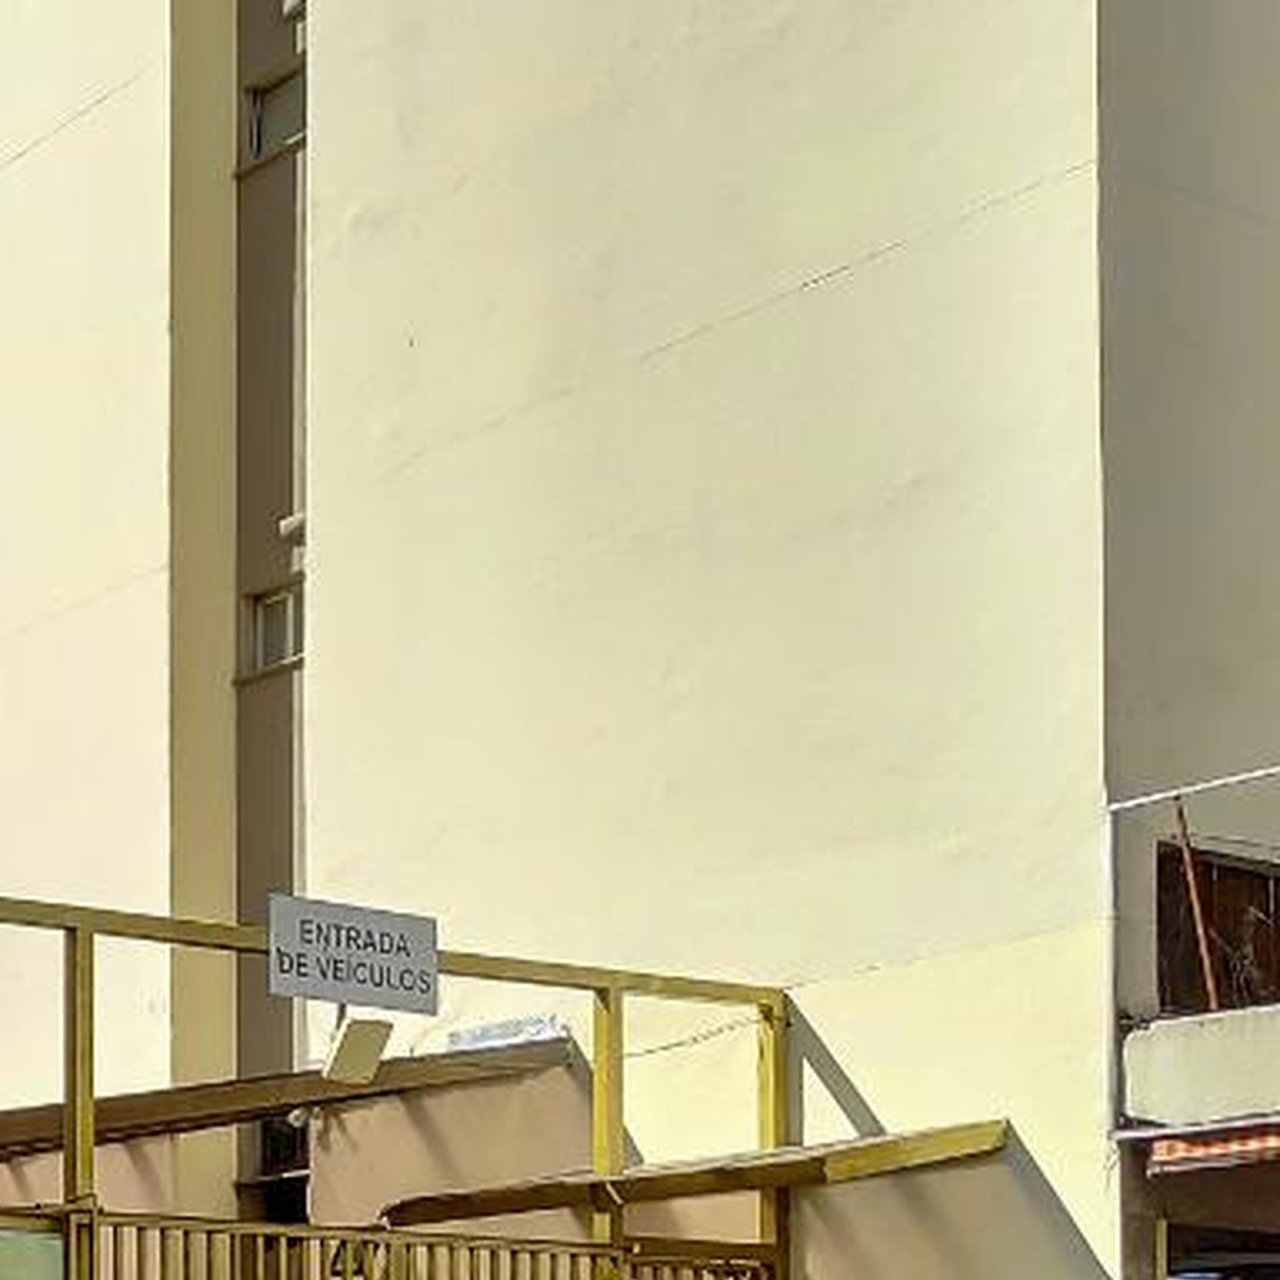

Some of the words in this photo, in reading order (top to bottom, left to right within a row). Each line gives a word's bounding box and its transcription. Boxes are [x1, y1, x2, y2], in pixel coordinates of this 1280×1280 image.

[298, 918, 411, 958] ENTRADA
[279, 951, 309, 978] DE
[316, 956, 432, 995] VEÍCULOS
